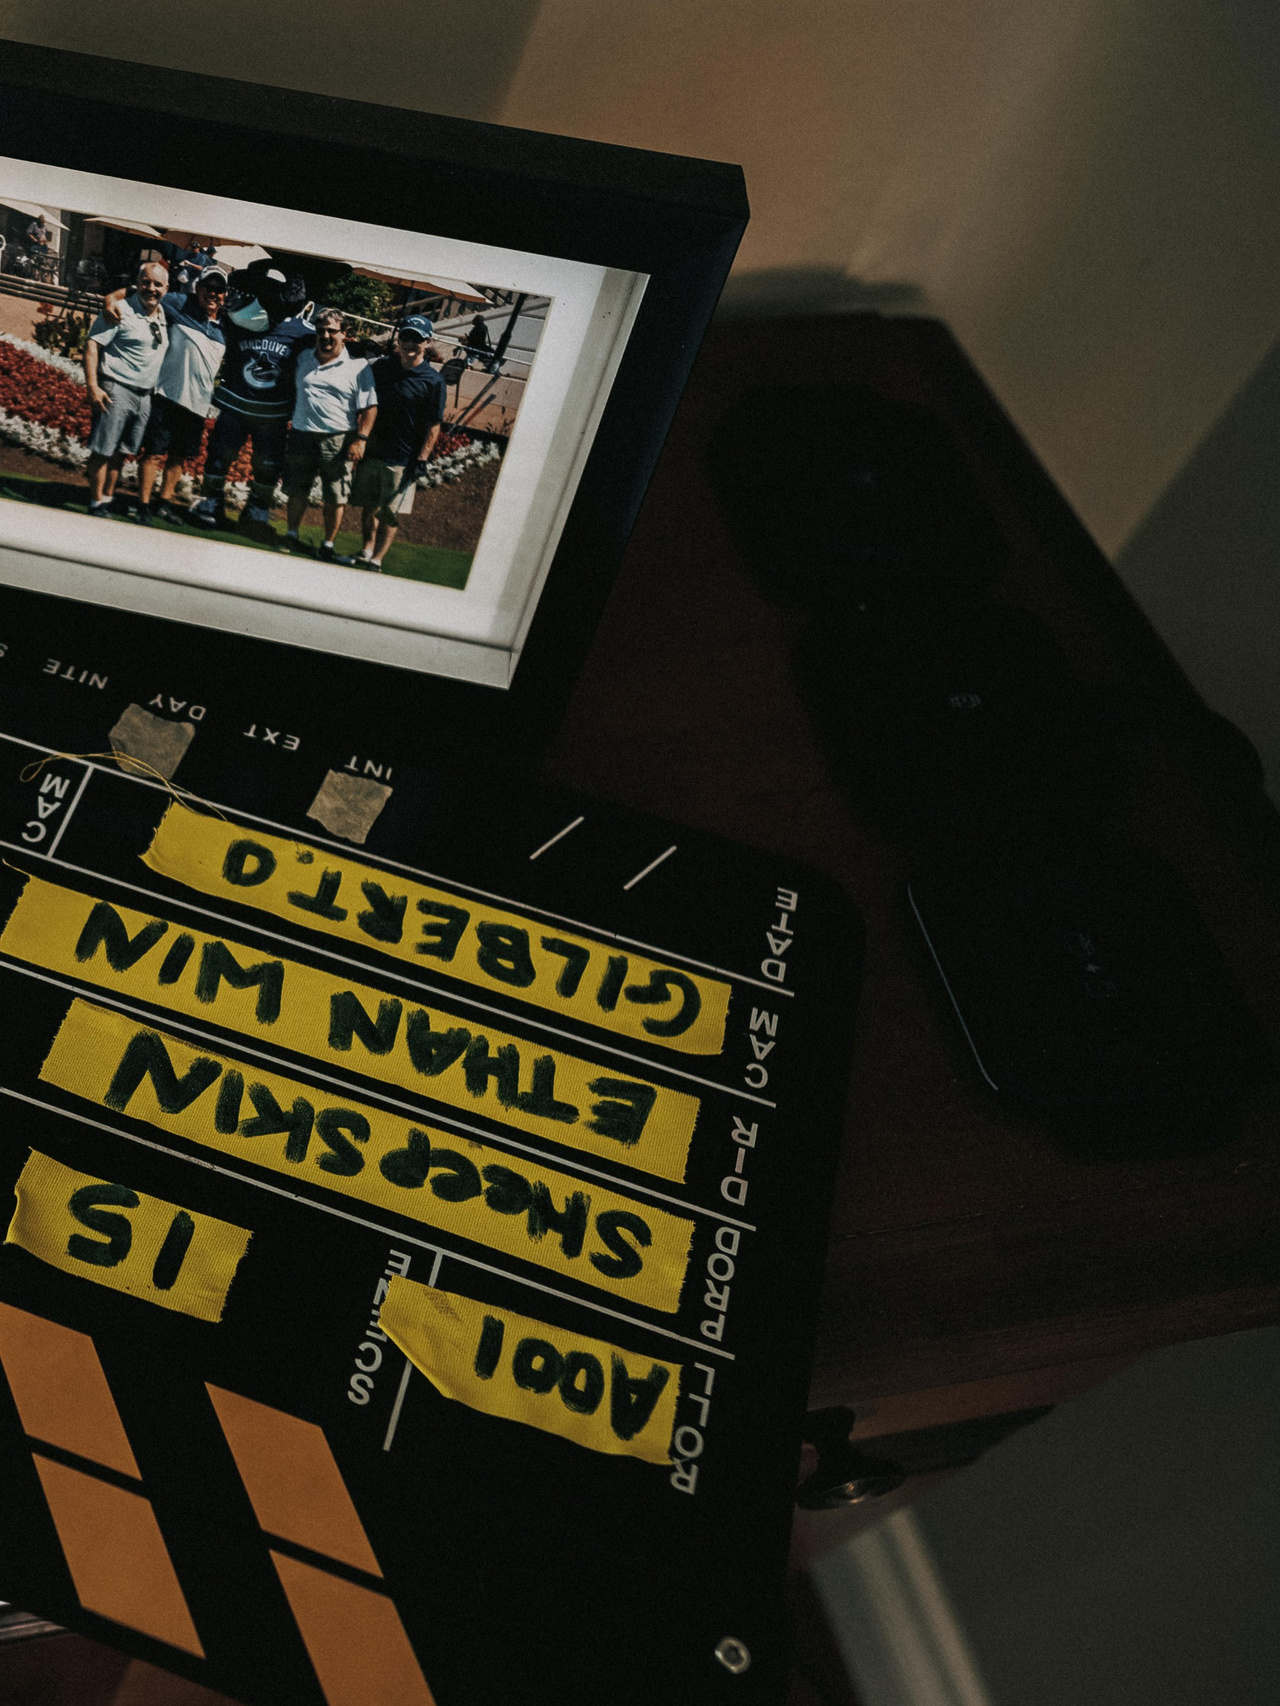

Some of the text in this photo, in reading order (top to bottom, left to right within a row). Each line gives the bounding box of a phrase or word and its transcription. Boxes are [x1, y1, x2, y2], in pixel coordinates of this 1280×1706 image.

[42, 658, 109, 690] NITE
[148, 693, 207, 721] DAY
[243, 723, 301, 751] EXT
[344, 755, 393, 781] INT
[21, 771, 70, 844] CAM
[761, 886, 799, 983] DATE
[74, 901, 659, 1149] ETHAN WIN
[744, 1006, 780, 1089] CAM
[720, 1115, 759, 1207] DIR
[699, 1226, 741, 1342] PROD
[669, 1361, 716, 1495] ROLL
